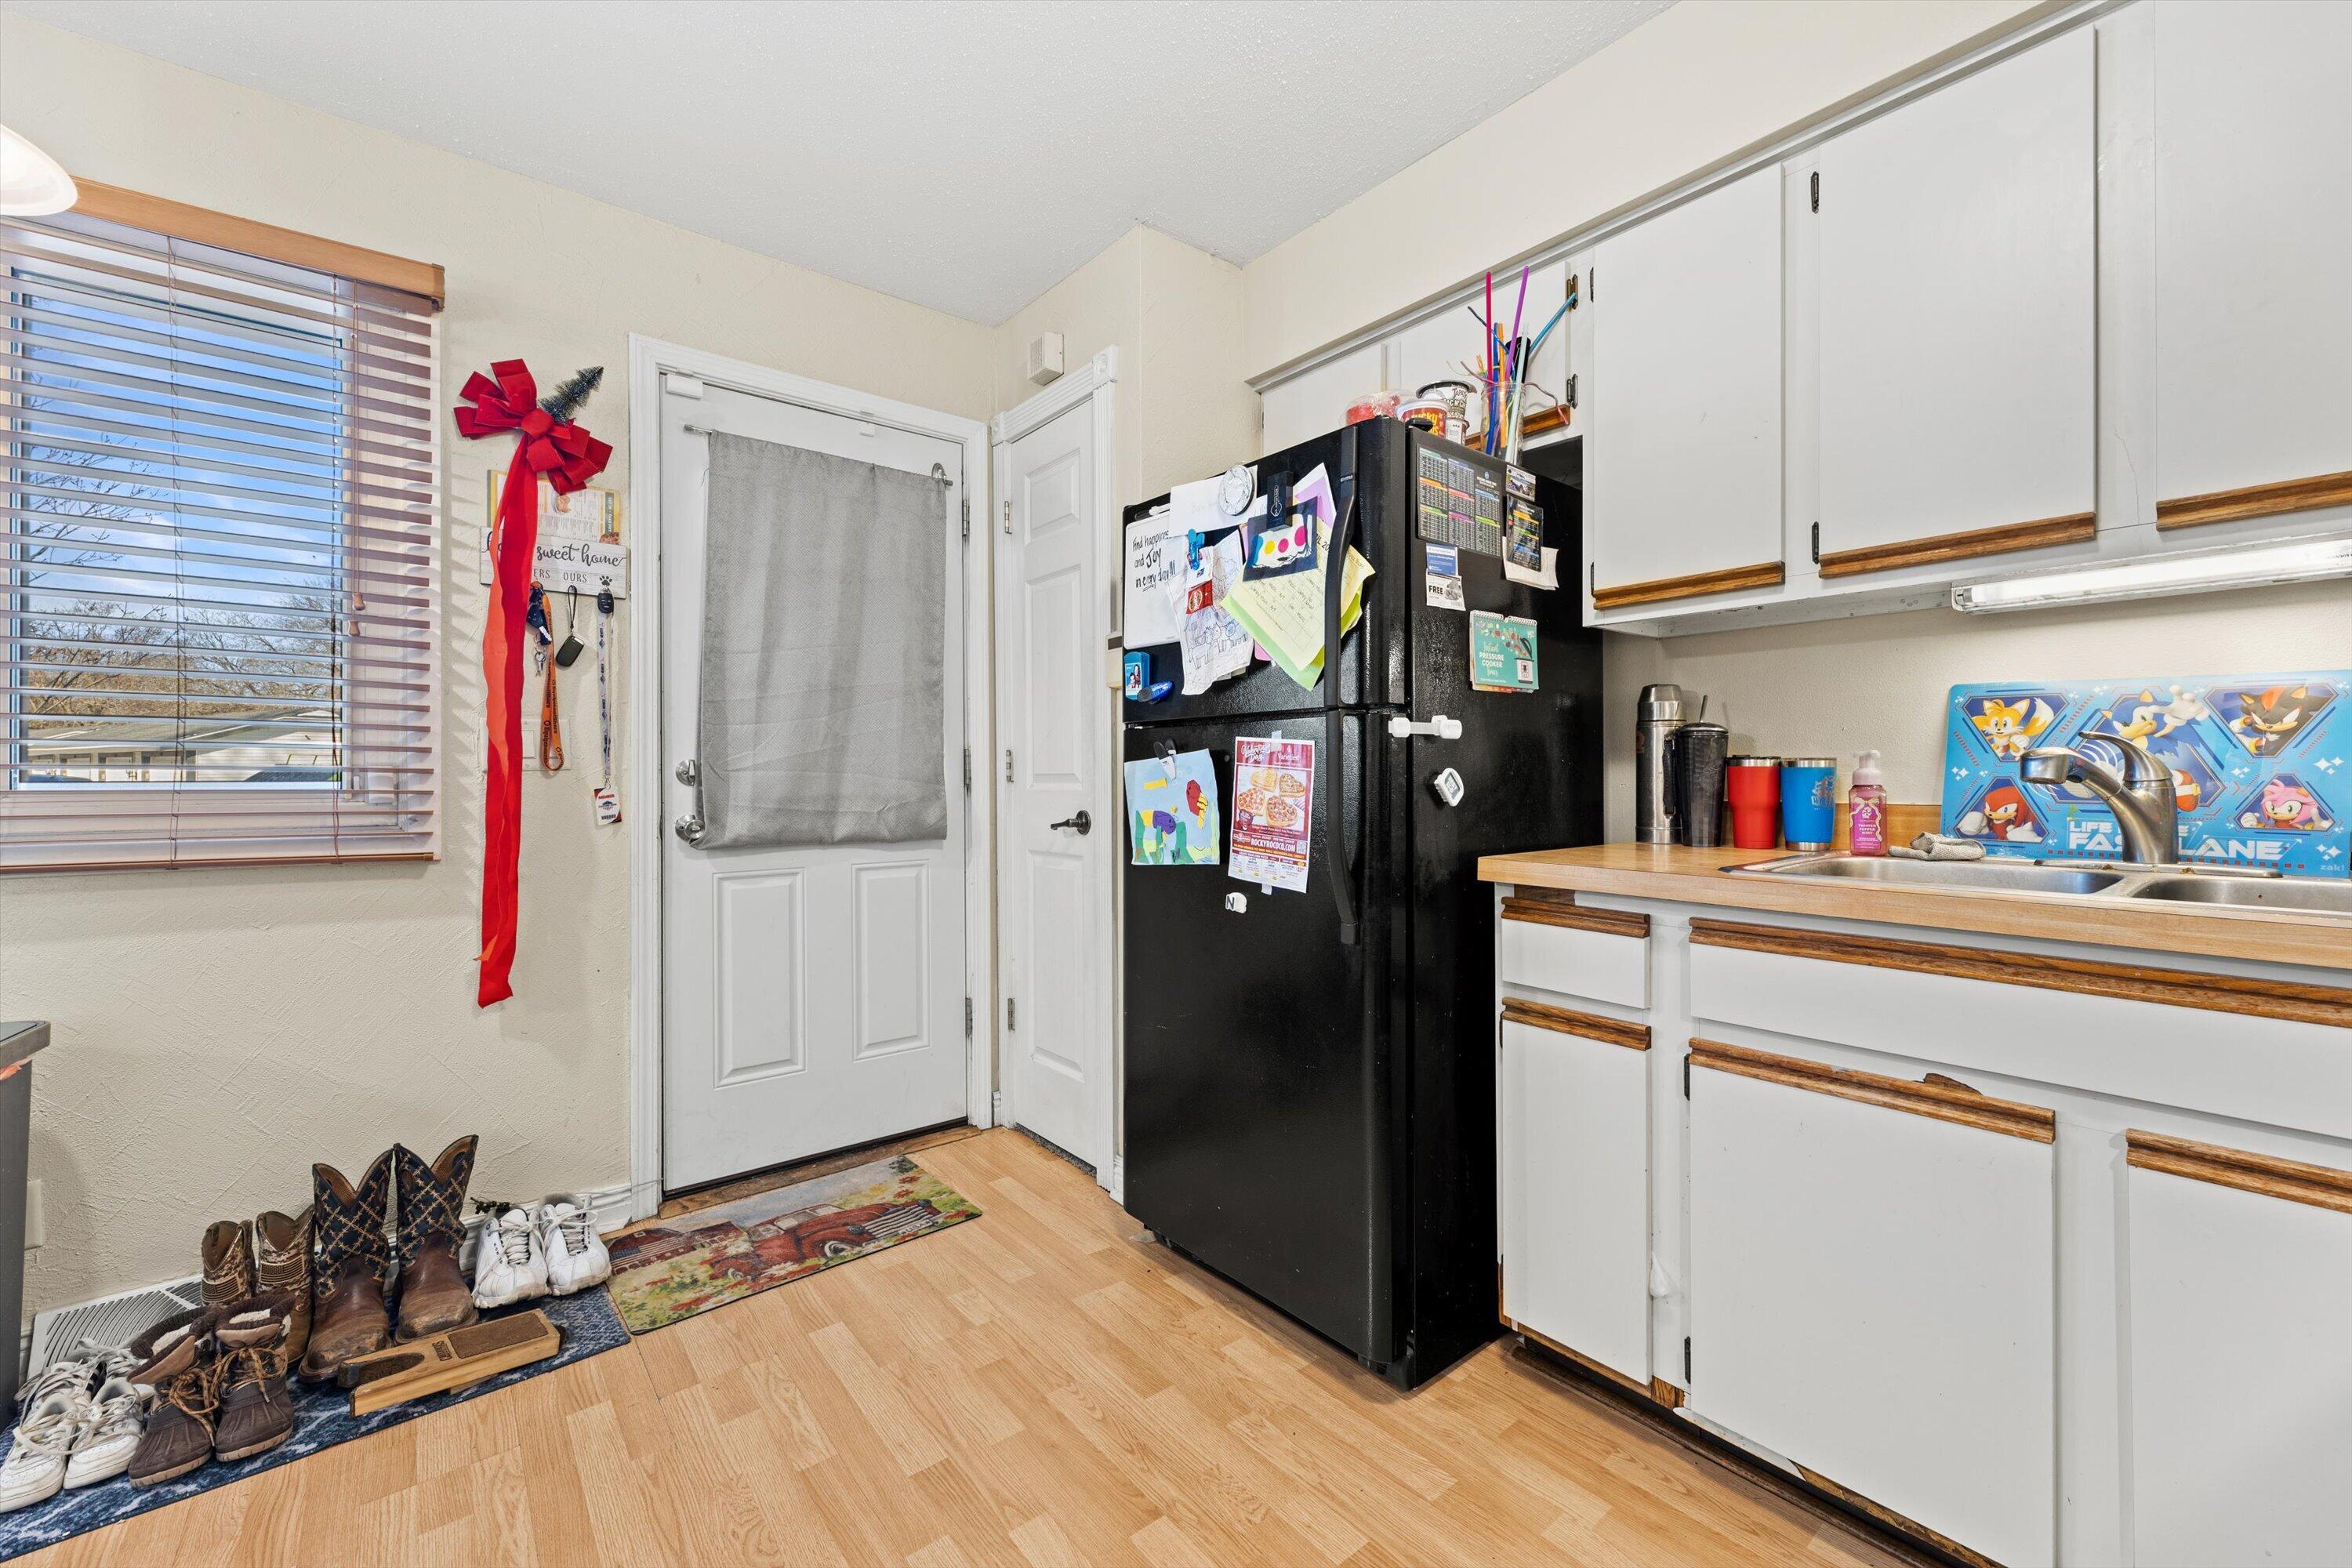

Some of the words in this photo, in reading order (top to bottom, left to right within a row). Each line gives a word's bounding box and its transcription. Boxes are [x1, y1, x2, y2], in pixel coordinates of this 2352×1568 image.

[1133, 535, 1143, 552] Find
[537, 543, 579, 561] sweet
[581, 543, 626, 567] home
[1134, 554, 1144, 568] and
[533, 568, 550, 579] ERS
[563, 571, 587, 583] OURS
[1136, 579, 1142, 588] in
[1428, 585, 1443, 595] FREE
[1479, 652, 1504, 661] PRESSURE
[1287, 744, 1291, 753] 4
[2070, 821, 2113, 833] LIFE
[1251, 838, 1296, 853] ROCKYROCOCO.COM
[2179, 838, 2287, 861] LANE
[1226, 895, 1235, 910] N
